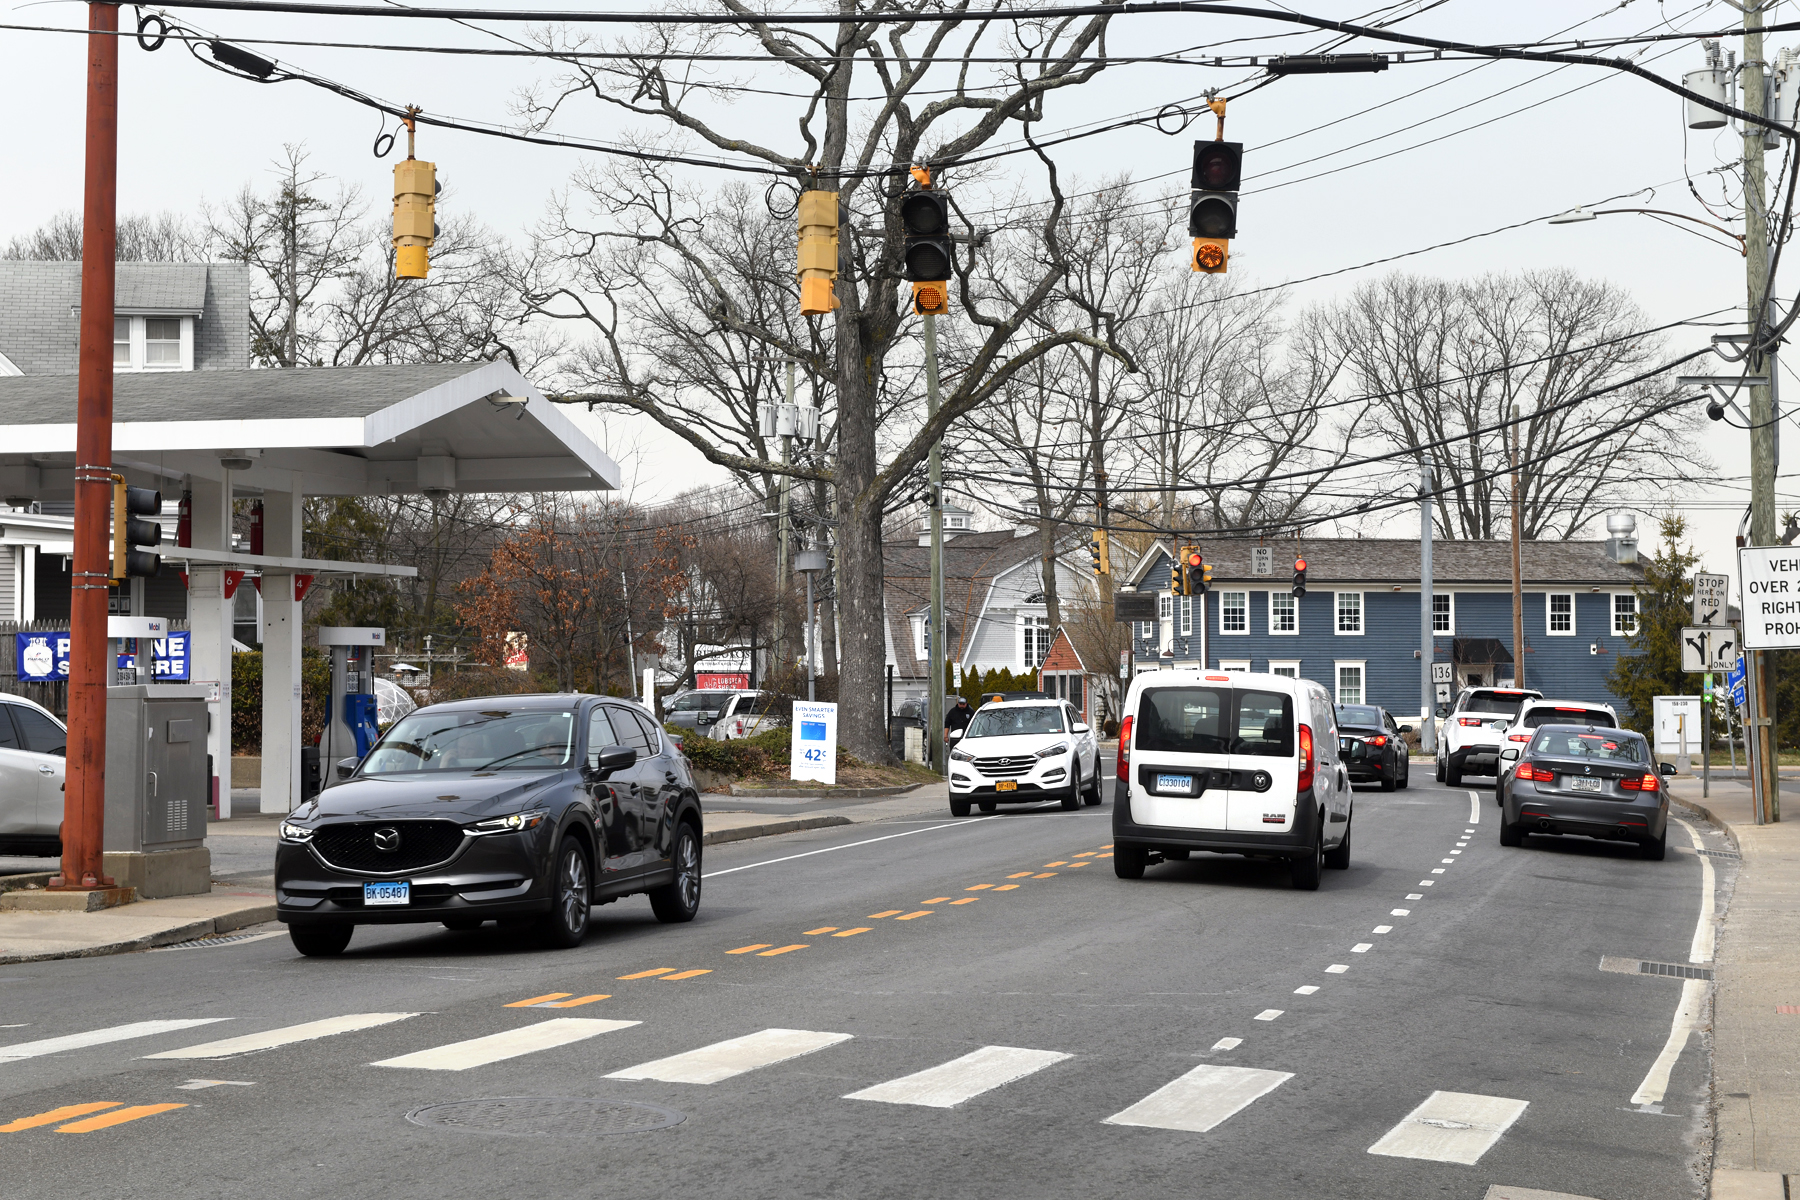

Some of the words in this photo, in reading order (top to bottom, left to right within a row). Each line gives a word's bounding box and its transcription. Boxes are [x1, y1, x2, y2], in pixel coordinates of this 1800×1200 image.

[1769, 559, 1800, 572] VEH
[226, 577, 232, 585] 6
[296, 580, 302, 588] 4
[1698, 578, 1724, 587] STOP
[1750, 580, 1789, 594] OVER
[1701, 598, 1720, 607] RED
[1434, 667, 1450, 678] 136
